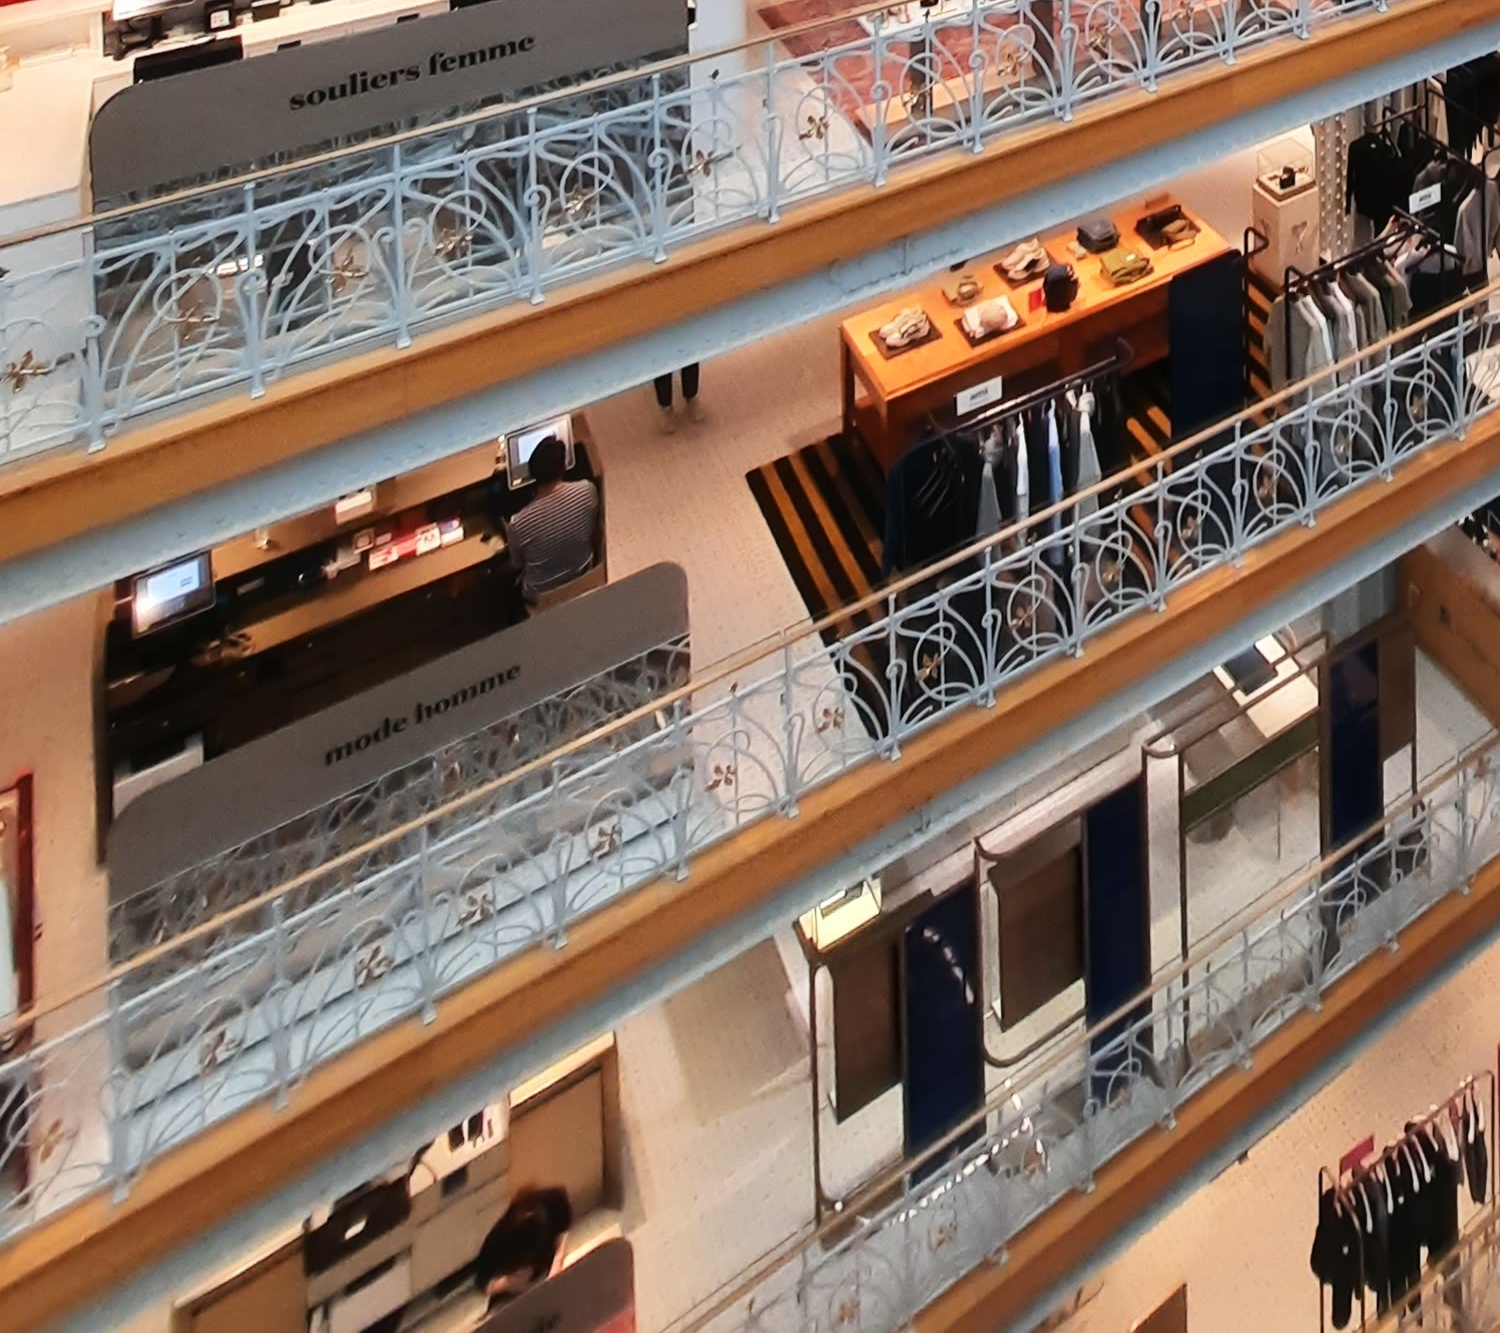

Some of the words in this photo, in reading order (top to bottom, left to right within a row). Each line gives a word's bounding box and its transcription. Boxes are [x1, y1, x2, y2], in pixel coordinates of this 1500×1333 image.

[289, 62, 421, 110] souliers
[427, 36, 536, 76] femme
[324, 717, 409, 767] mode
[413, 664, 521, 726] homme
